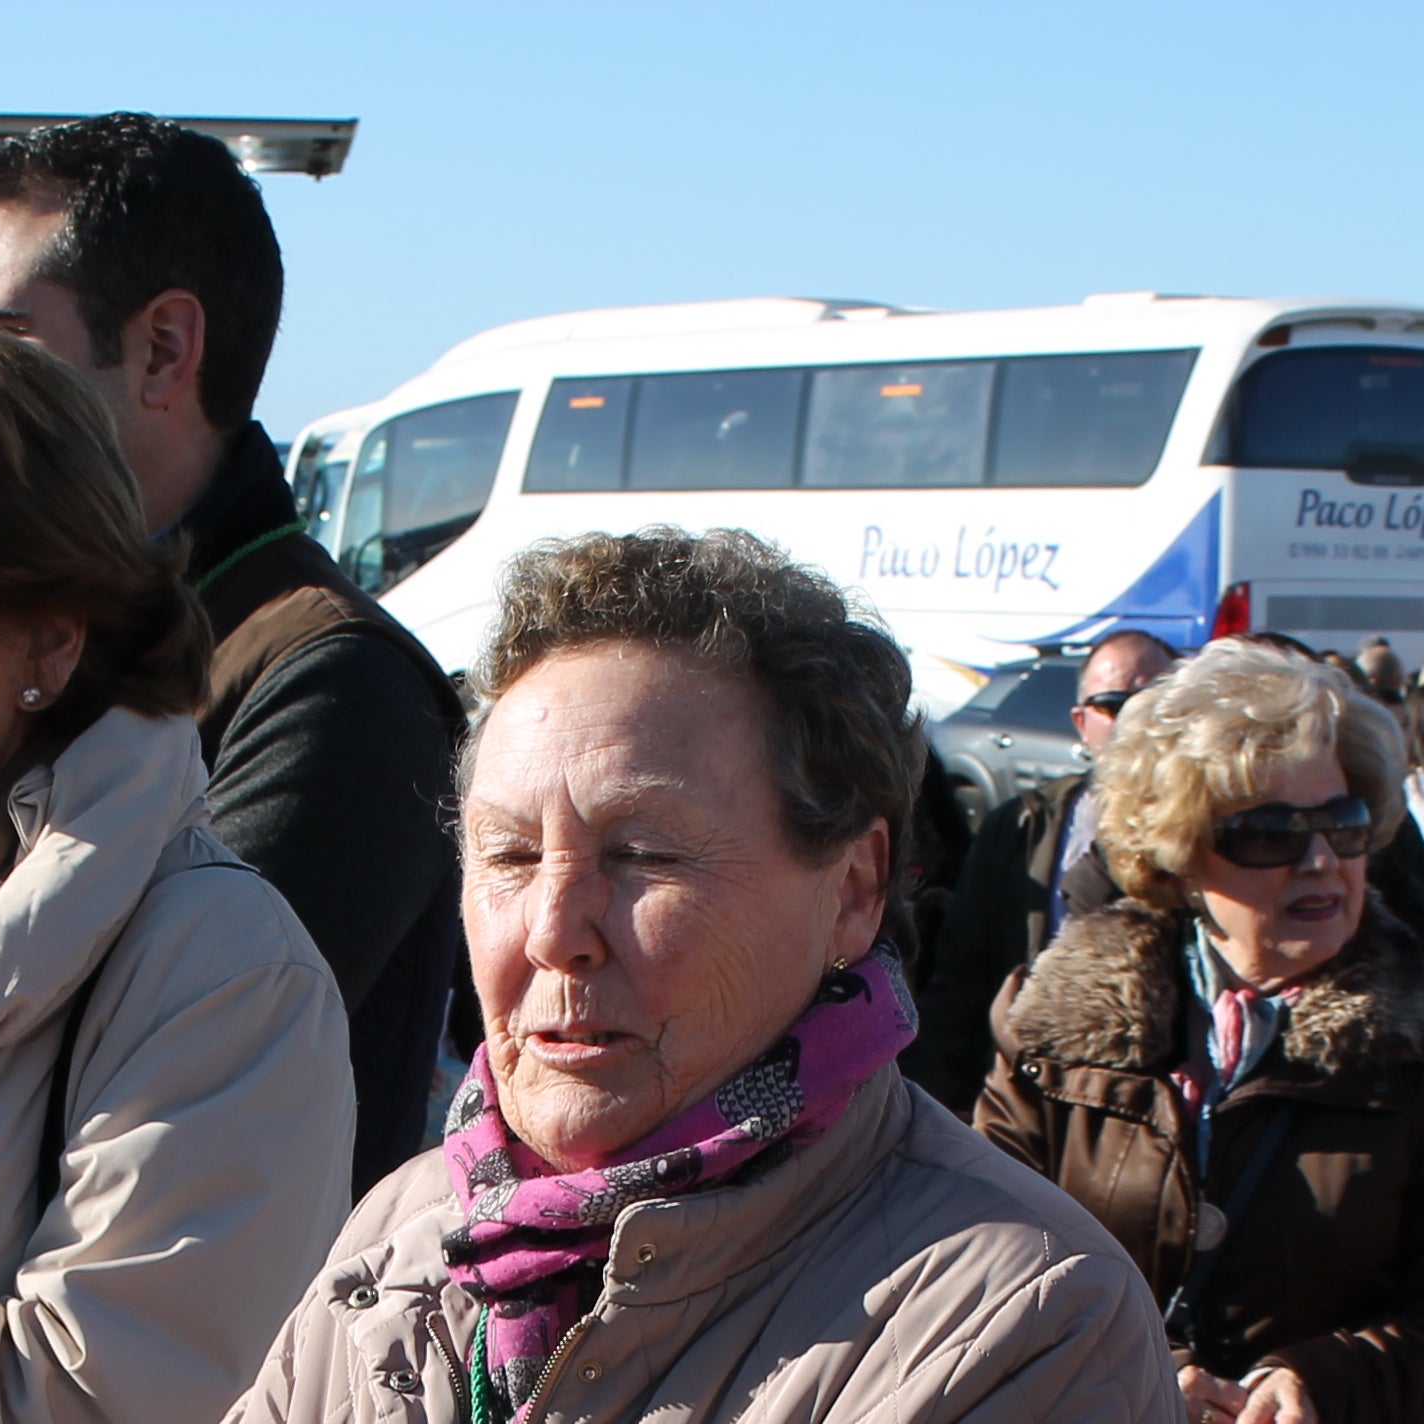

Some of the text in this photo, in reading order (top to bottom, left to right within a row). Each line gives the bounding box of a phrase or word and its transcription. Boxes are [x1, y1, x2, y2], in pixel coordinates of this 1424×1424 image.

[1295, 488, 1375, 529] Paco
[860, 524, 1061, 592] Paco López
